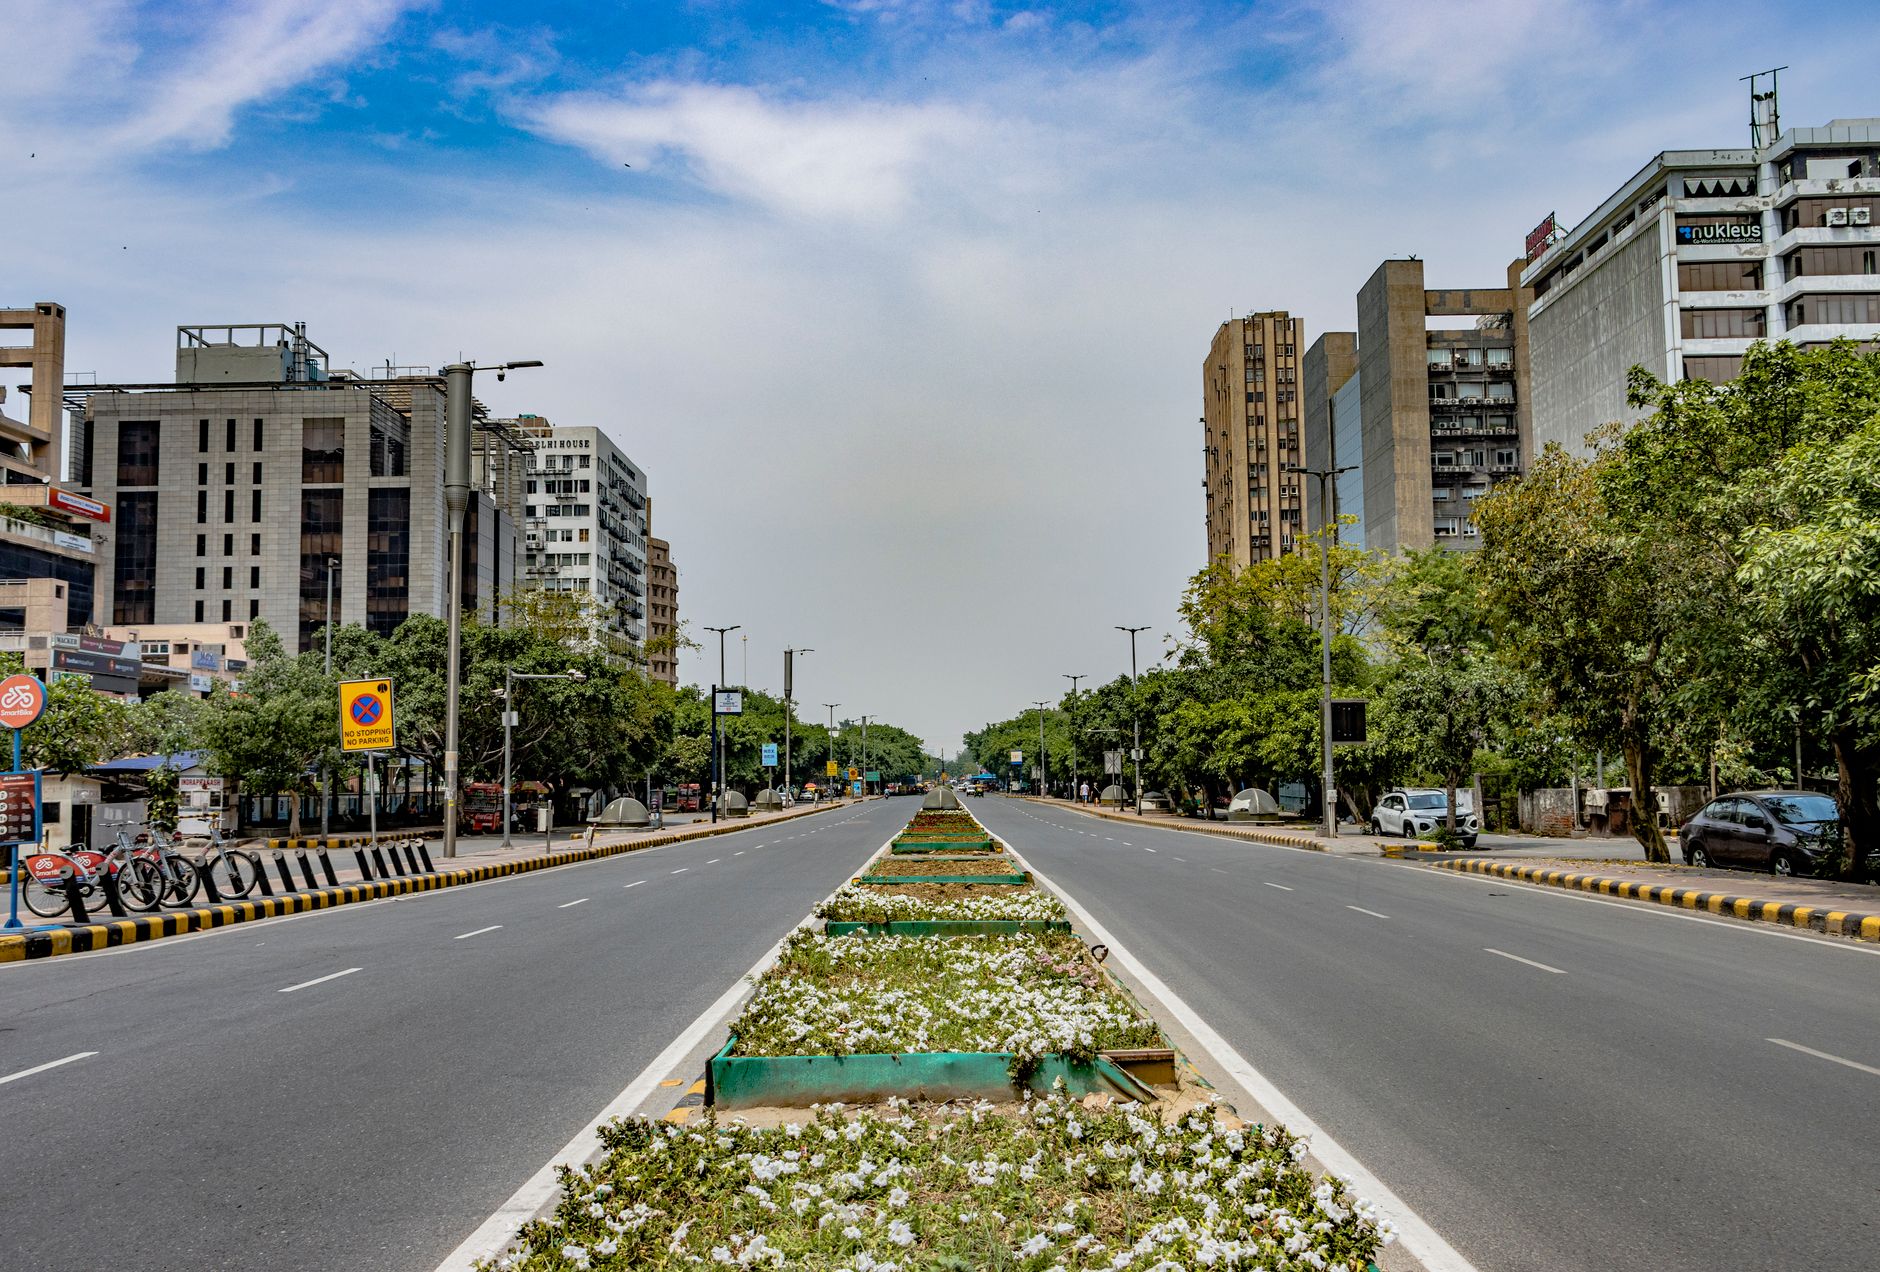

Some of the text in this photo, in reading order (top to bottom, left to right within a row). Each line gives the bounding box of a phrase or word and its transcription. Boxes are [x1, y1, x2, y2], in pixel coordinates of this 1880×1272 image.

[1692, 222, 1761, 239] nukleus
[559, 440, 590, 449] HOUSE
[356, 728, 391, 737] STOPPING
[358, 736, 389, 745] PARKING
